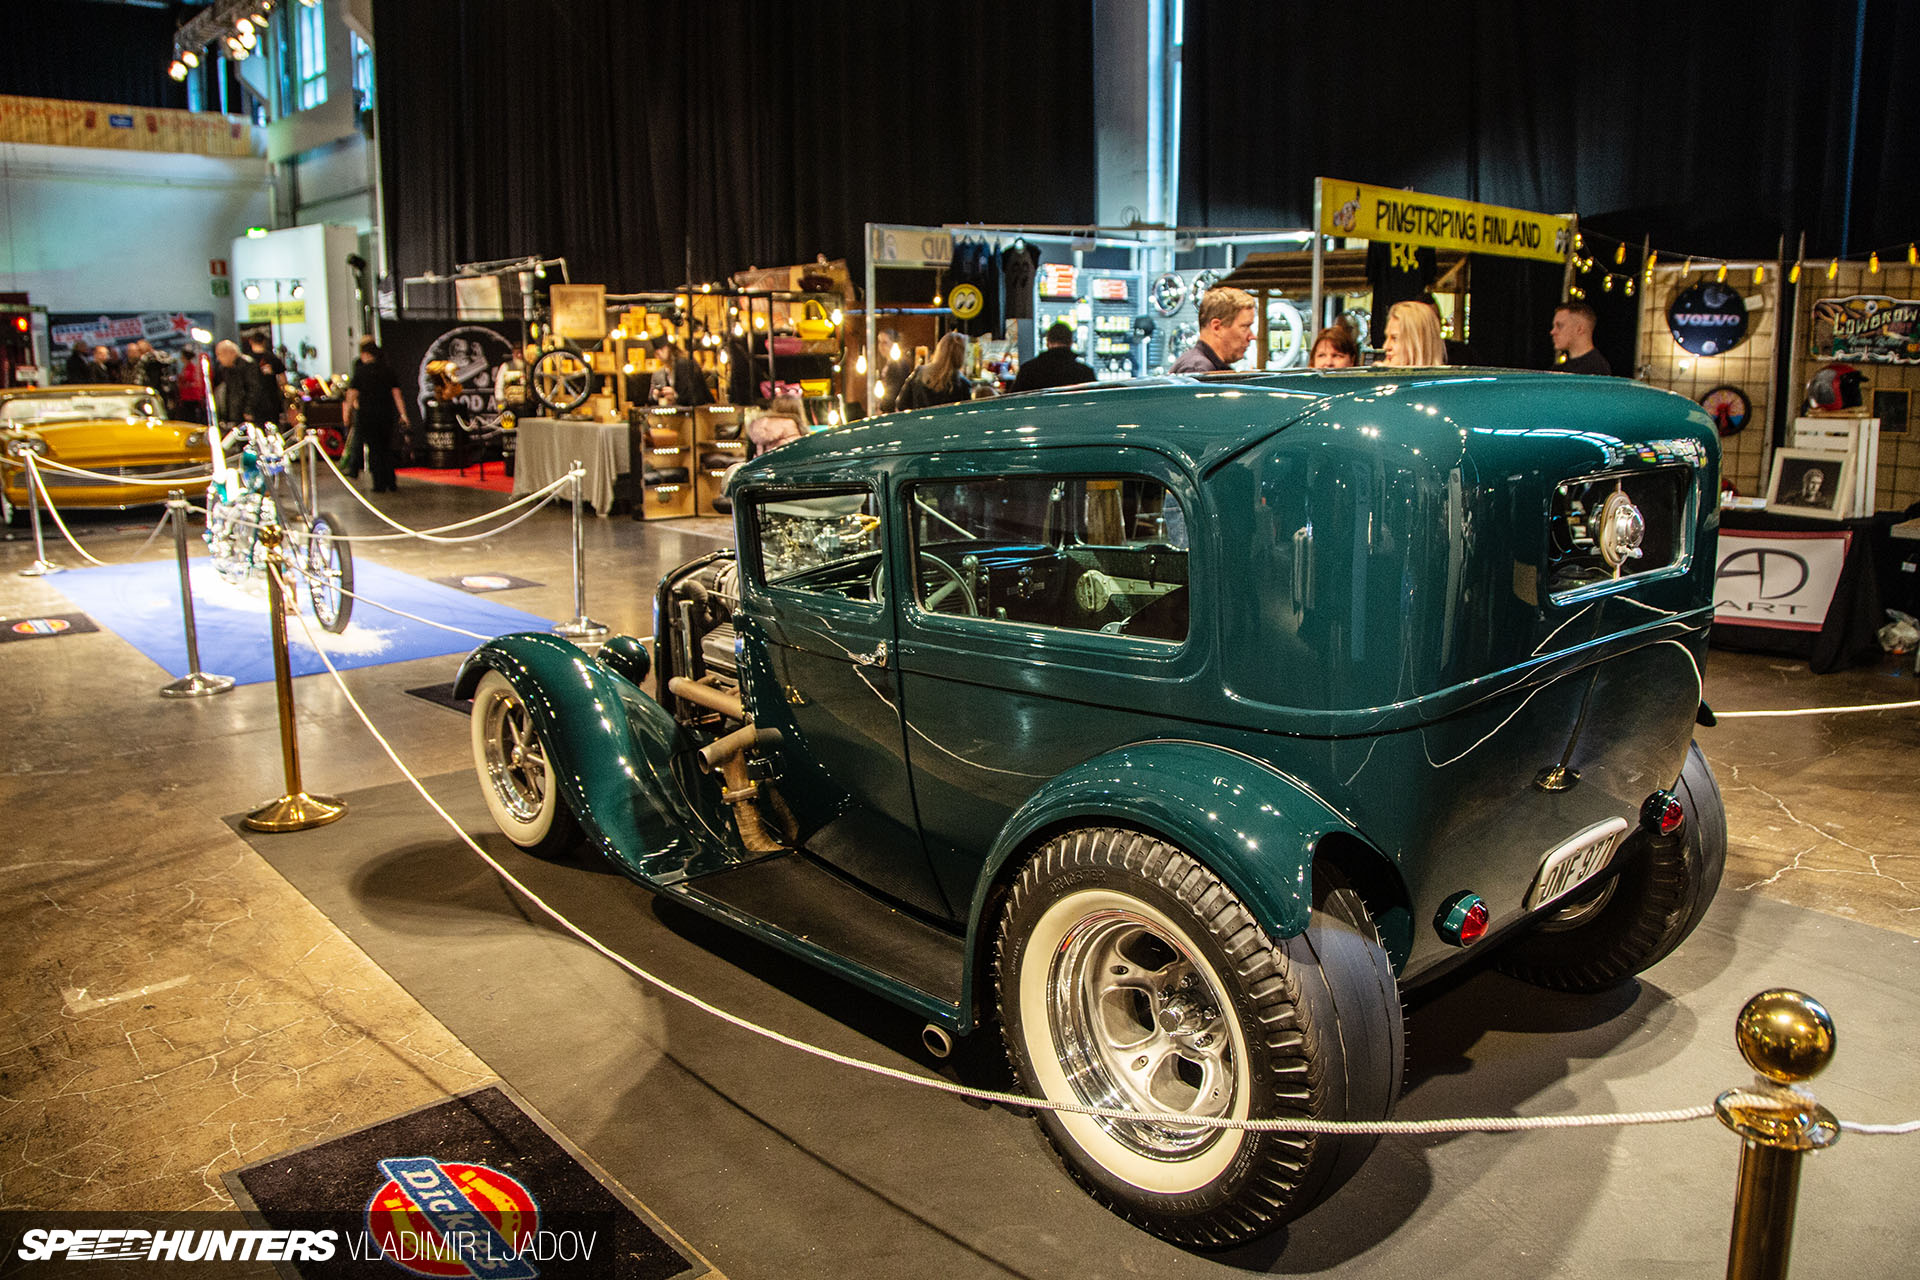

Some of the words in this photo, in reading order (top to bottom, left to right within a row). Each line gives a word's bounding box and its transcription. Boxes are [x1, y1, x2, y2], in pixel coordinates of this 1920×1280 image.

[1376, 200, 1477, 243] PINSTRIPING
[1483, 216, 1542, 249] FINLAND
[1674, 313, 1741, 327] VOLVO
[1833, 307, 1919, 336] LOWBROW
[1715, 547, 1809, 600] AD
[1714, 600, 1808, 615] ART
[400, 1168, 509, 1271] Dickies
